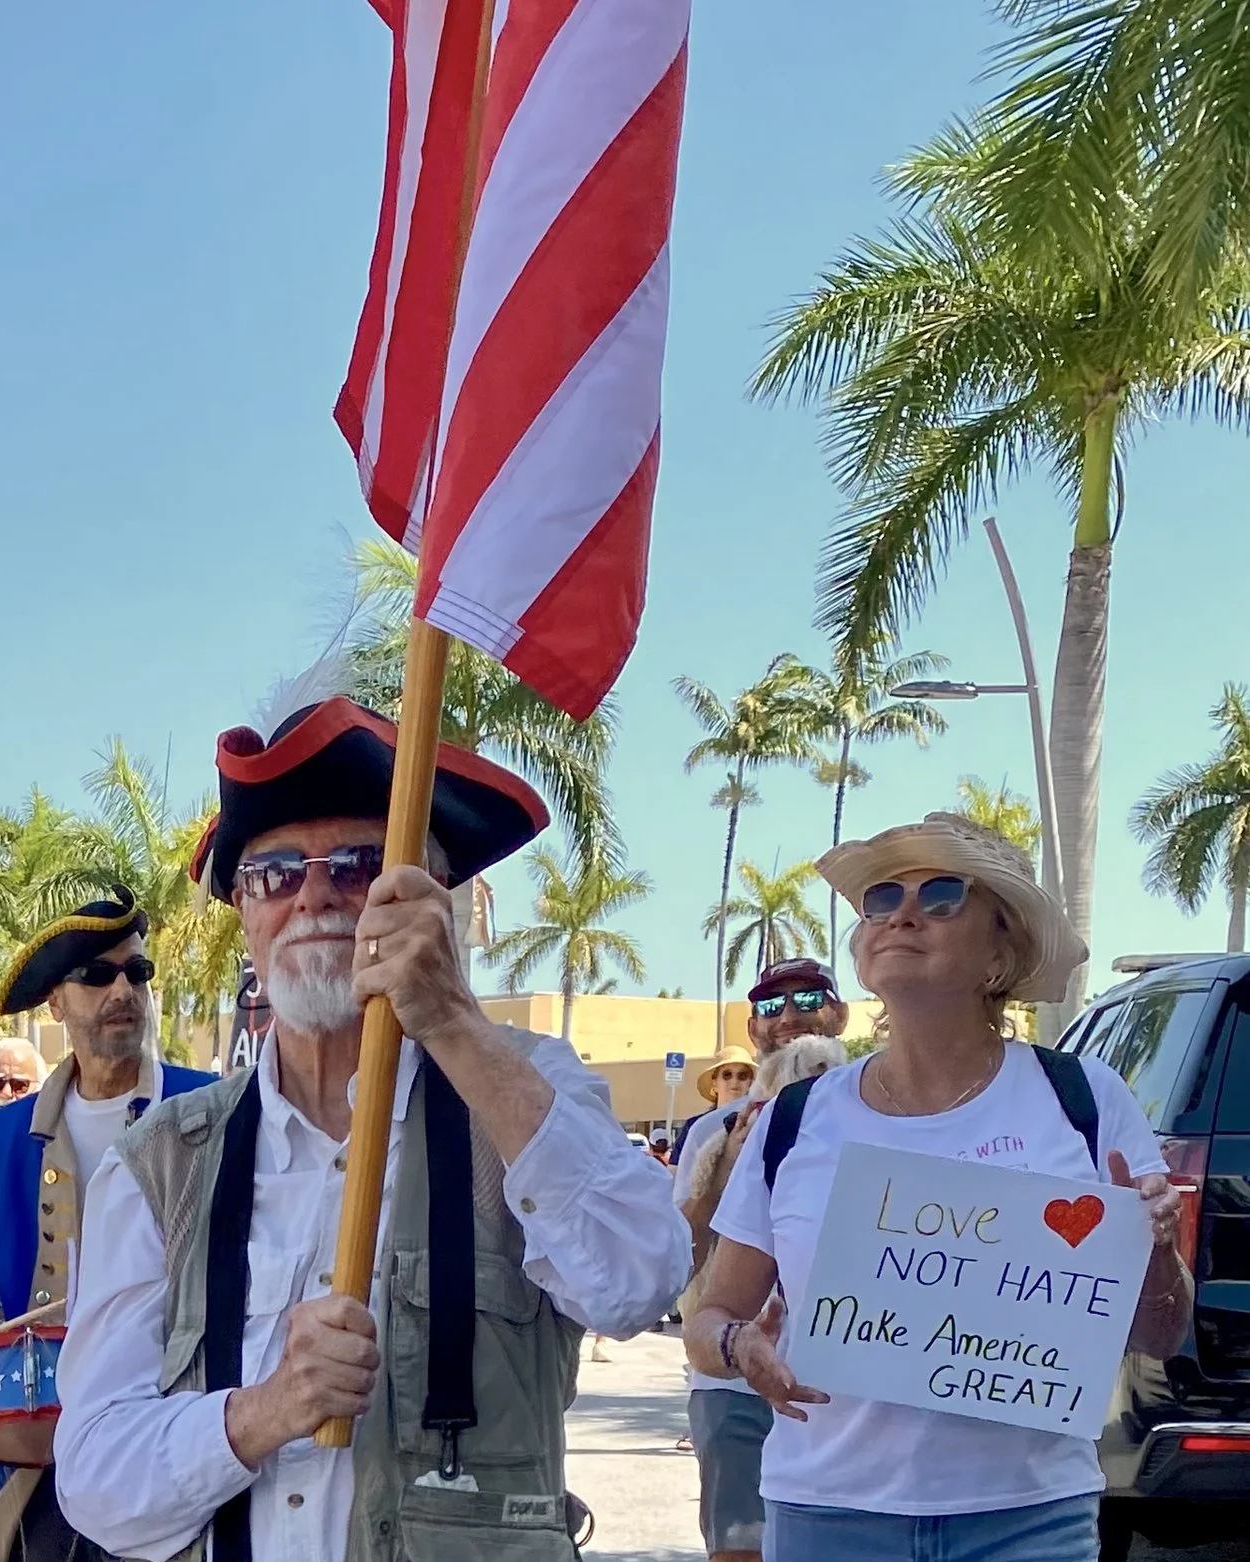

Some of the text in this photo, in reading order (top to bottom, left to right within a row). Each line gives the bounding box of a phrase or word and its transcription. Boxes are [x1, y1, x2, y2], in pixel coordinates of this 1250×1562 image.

[976, 1135, 1024, 1159] WITH
[876, 1177, 1002, 1244] Love
[876, 1246, 1120, 1318] NOT HATE
[809, 1295, 1070, 1372] Make America
[928, 1364, 1084, 1424] GREAT!
